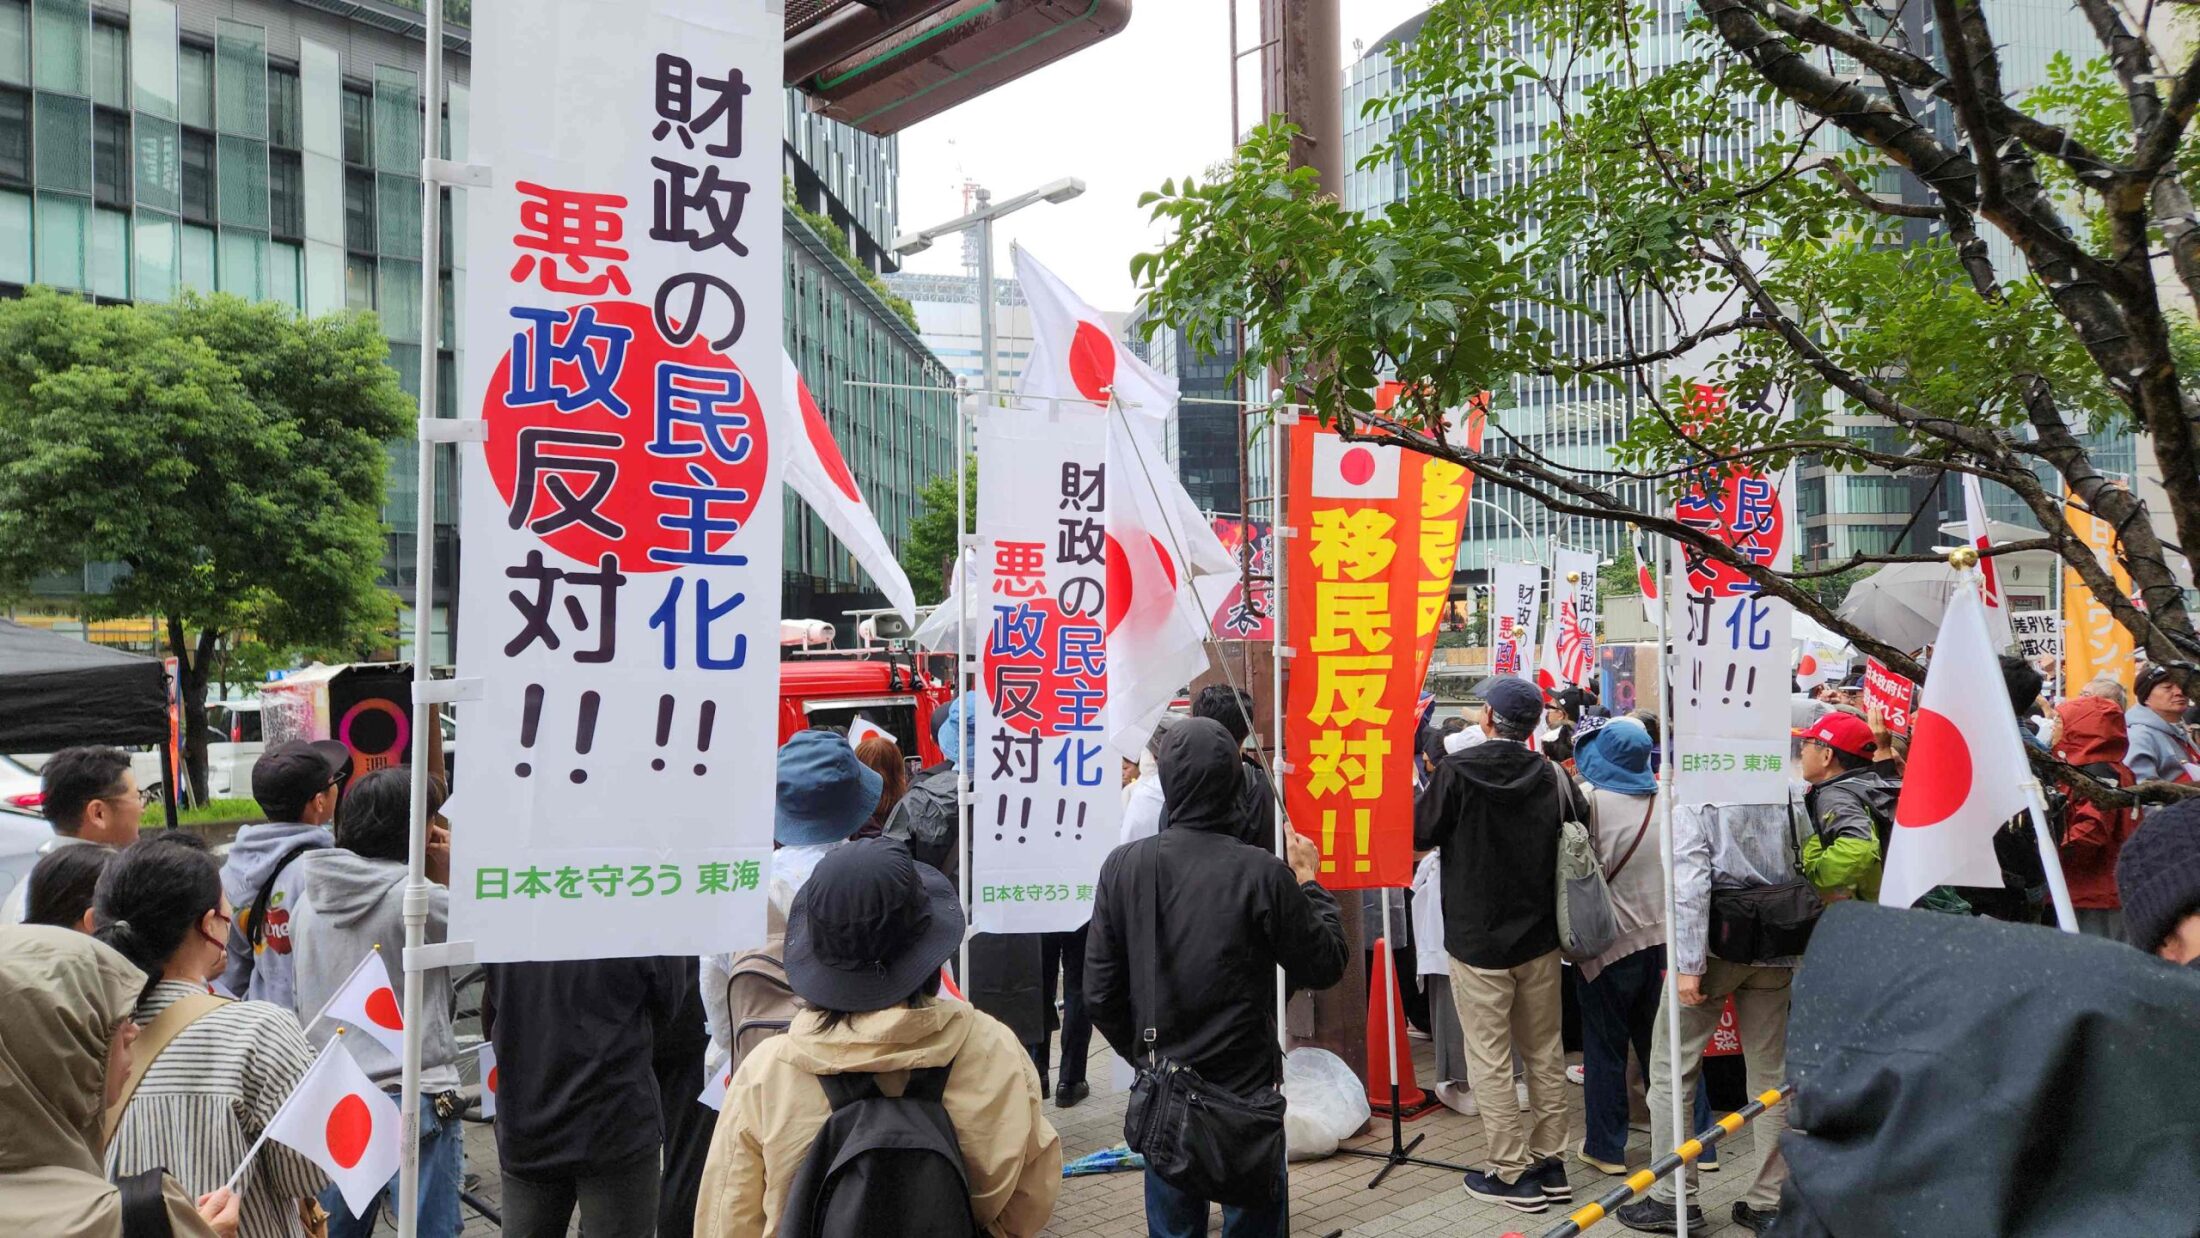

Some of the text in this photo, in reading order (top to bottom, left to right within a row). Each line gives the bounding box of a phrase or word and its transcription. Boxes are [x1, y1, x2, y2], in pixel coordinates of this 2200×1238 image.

[503, 180, 633, 785] 悪政反対!!
[648, 52, 751, 778] 財政の民主化!!
[990, 540, 1046, 844] 悪政反対!!
[1306, 508, 1398, 873] 移民反対!!
[1743, 753, 1782, 771] 東海
[475, 860, 761, 900] 日本を守ろう 東海
[983, 884, 1097, 902] 日本を守ろう 東
